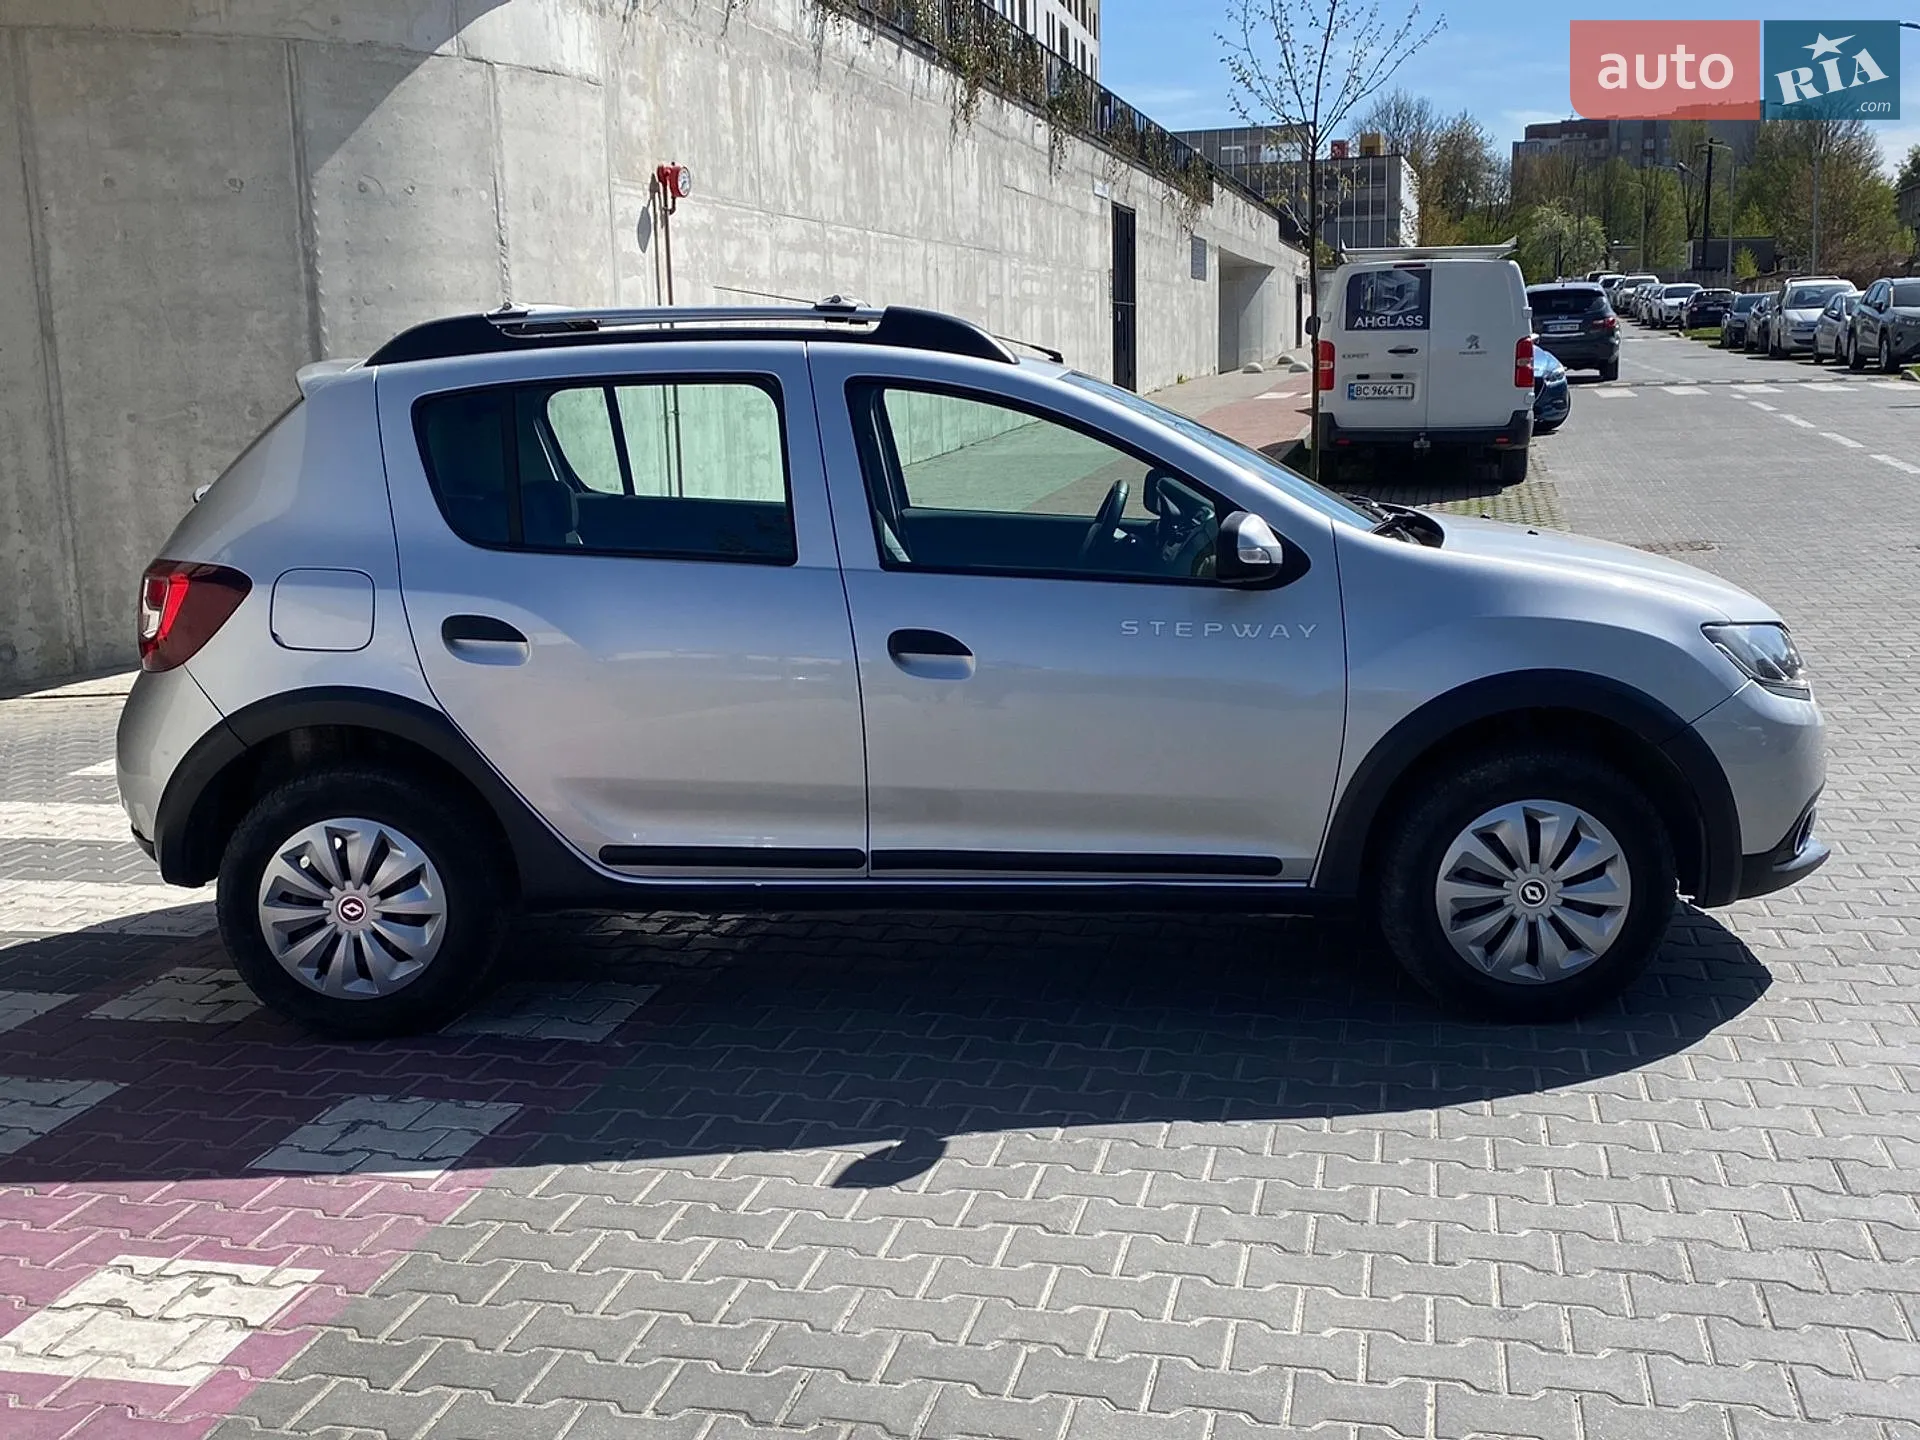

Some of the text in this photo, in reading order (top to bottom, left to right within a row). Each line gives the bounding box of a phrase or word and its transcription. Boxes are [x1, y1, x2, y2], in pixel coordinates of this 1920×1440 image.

[1356, 386, 1370, 396] BC
[1371, 386, 1394, 396] 9664
[1120, 620, 1318, 639] STEPWAY
